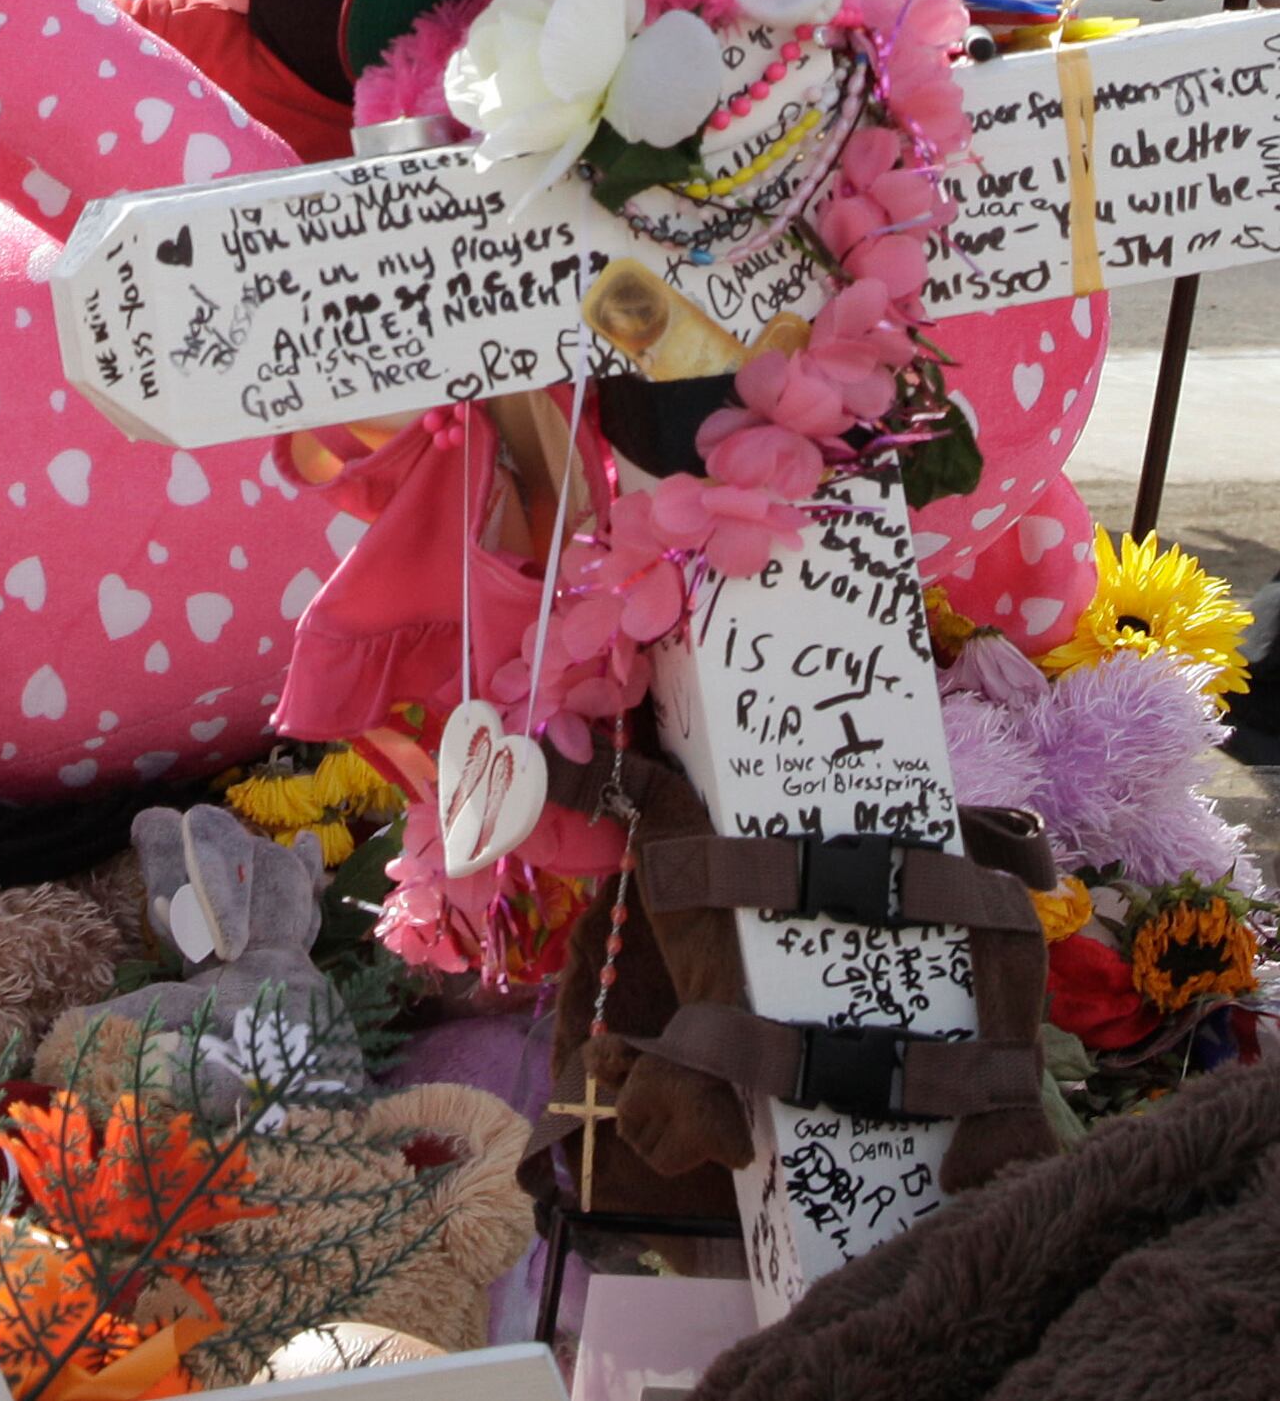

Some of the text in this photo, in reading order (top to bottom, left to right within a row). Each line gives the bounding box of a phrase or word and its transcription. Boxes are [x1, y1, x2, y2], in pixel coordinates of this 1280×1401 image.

[1127, 181, 1204, 217] will
[1207, 172, 1253, 207] be
[221, 228, 290, 273] you
[451, 221, 575, 269] prayers
[130, 330, 159, 400] miss
[241, 381, 305, 423] God
[330, 376, 358, 400] is
[799, 558, 899, 626] world
[724, 617, 774, 673] is
[729, 756, 765, 778] We
[776, 753, 815, 773] love
